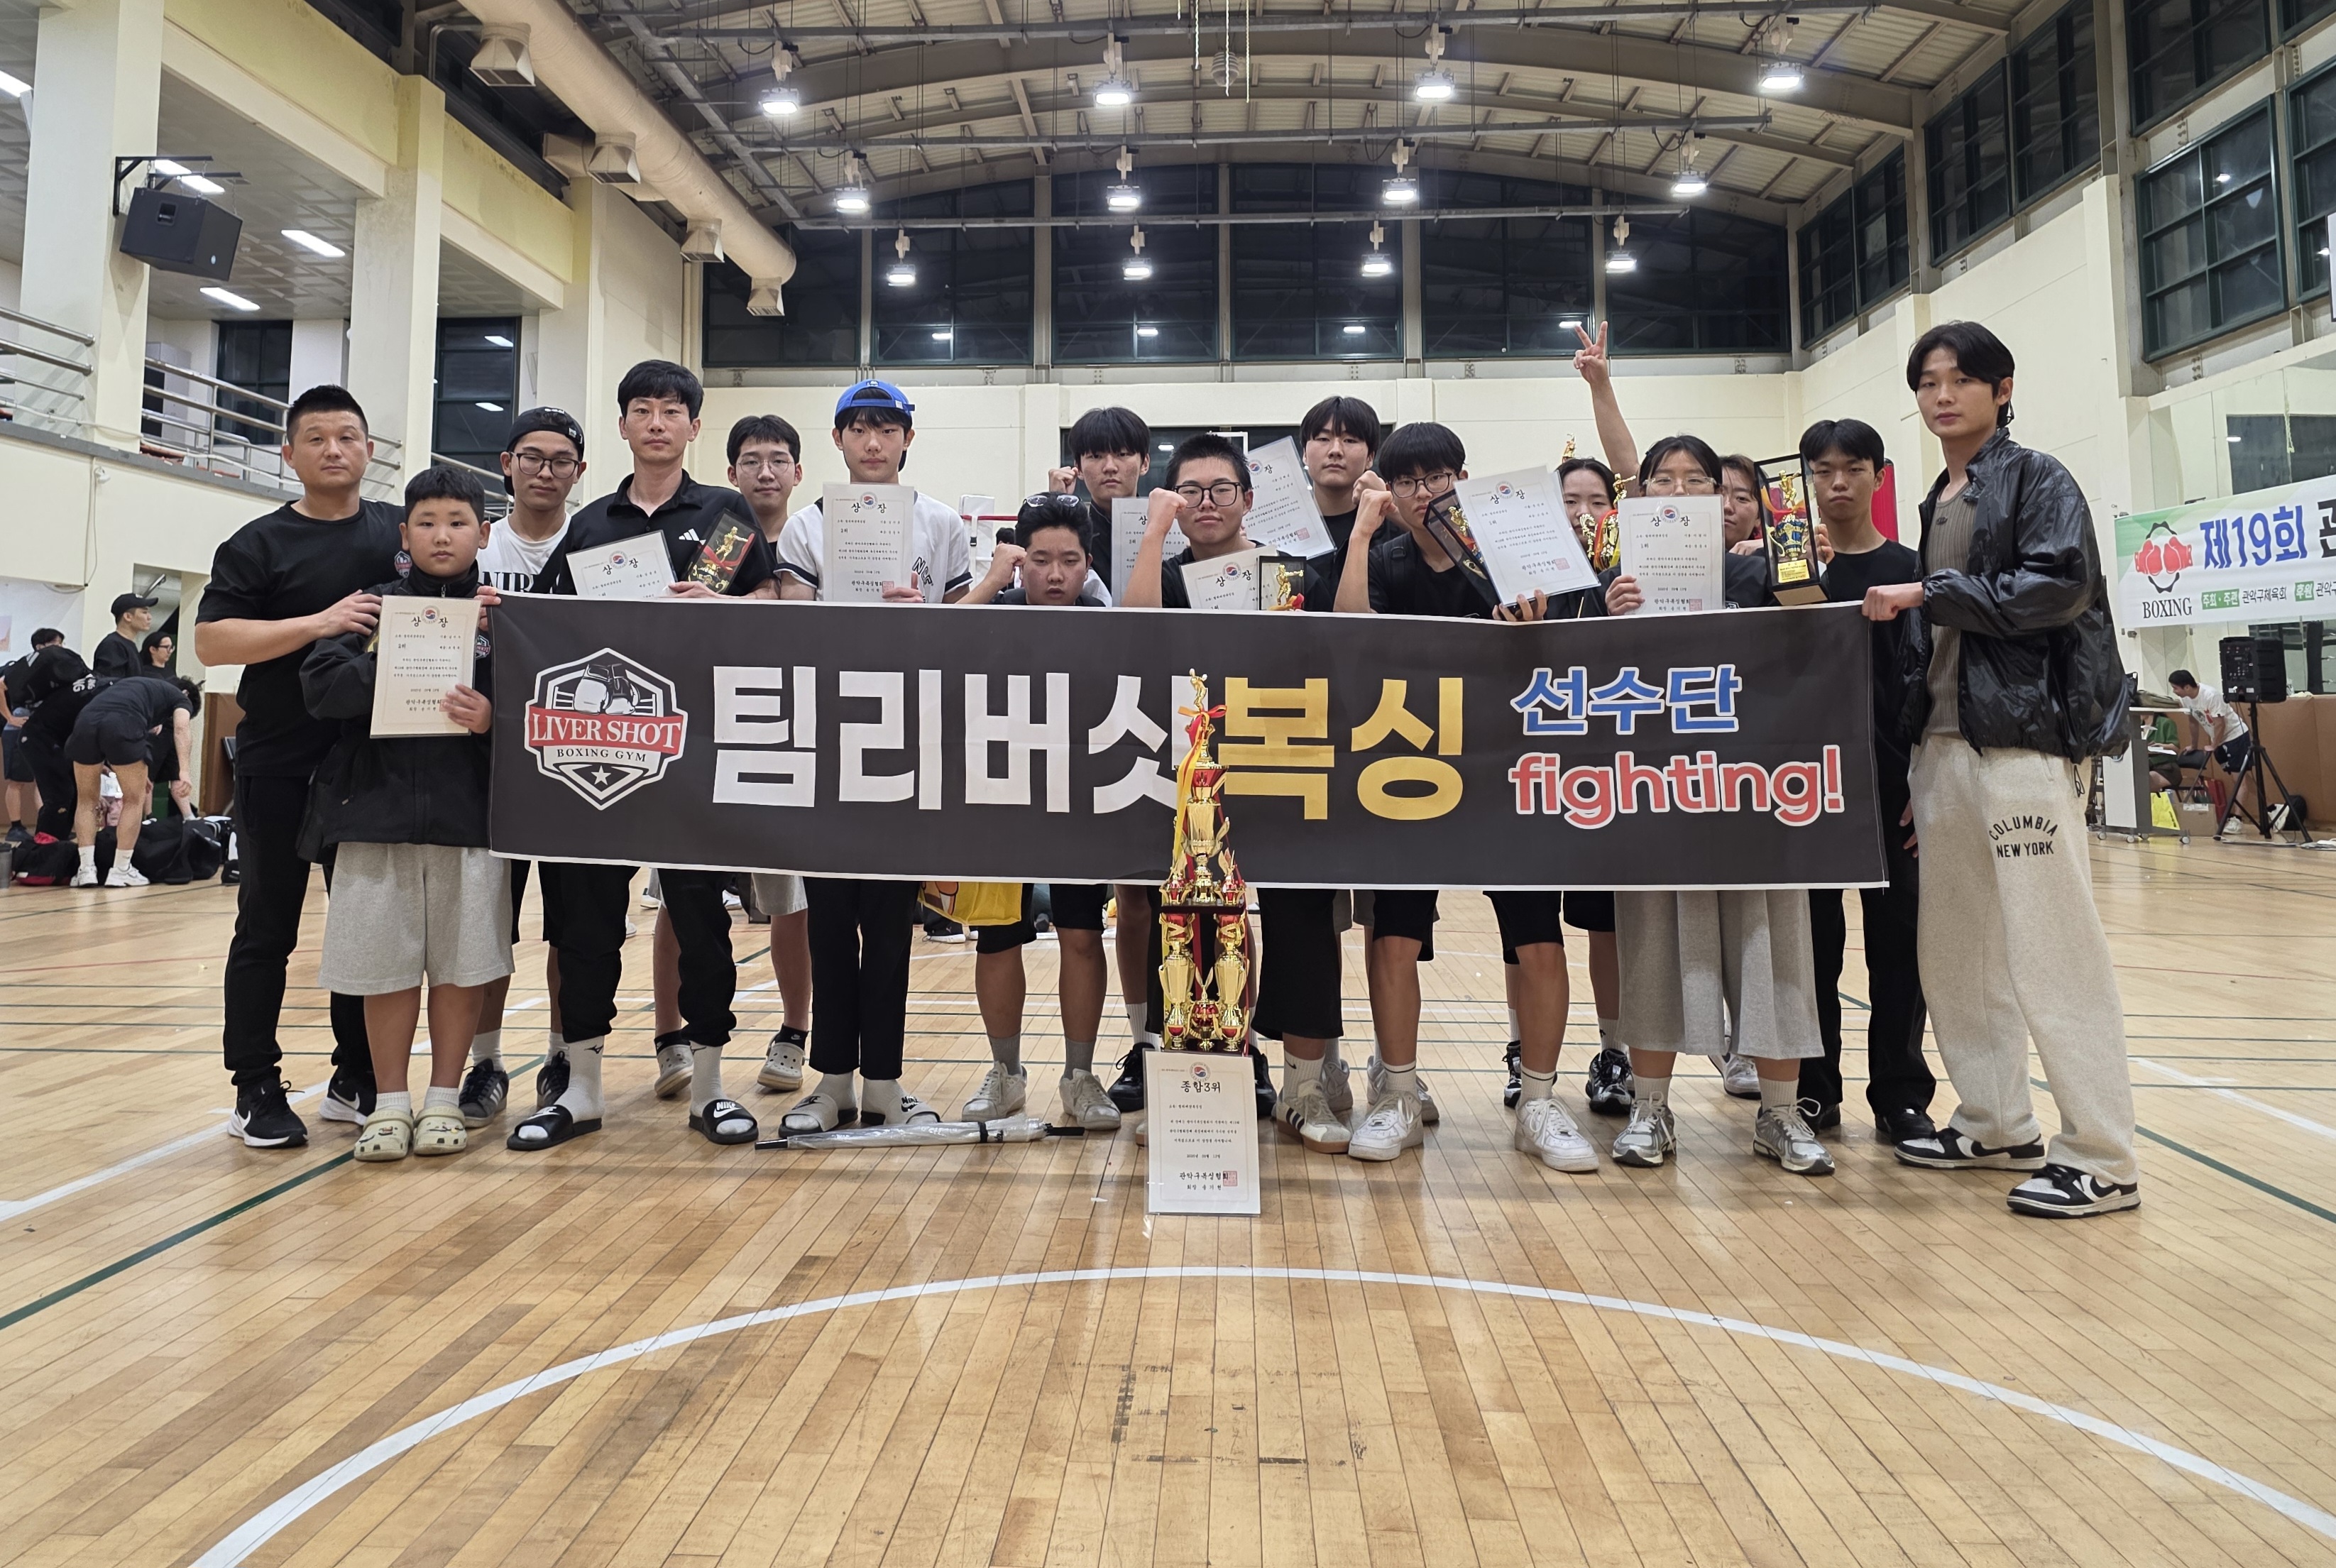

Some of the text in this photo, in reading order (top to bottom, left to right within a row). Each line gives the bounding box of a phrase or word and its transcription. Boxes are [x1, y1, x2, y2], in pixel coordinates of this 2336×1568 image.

[1490, 490, 1525, 505] 상 장
[851, 503, 887, 513] 상 장
[1139, 515, 1148, 525] 상
[1650, 516, 1690, 527] 상 장
[2200, 505, 2308, 569] 제19회
[603, 558, 638, 575] 상 장
[1215, 570, 1252, 587] 상 장
[2143, 598, 2192, 618] BOXING
[411, 617, 448, 628] 상 장
[1510, 664, 1742, 735] 선수단
[532, 713, 681, 749] LIVER SHOT
[557, 747, 647, 762] BOXING GYM
[1508, 745, 1845, 829] fighting!
[1989, 816, 2058, 840] COLUMBIA
[1996, 840, 2053, 858] NEW YORK
[1180, 1080, 1222, 1094] 종합3위
